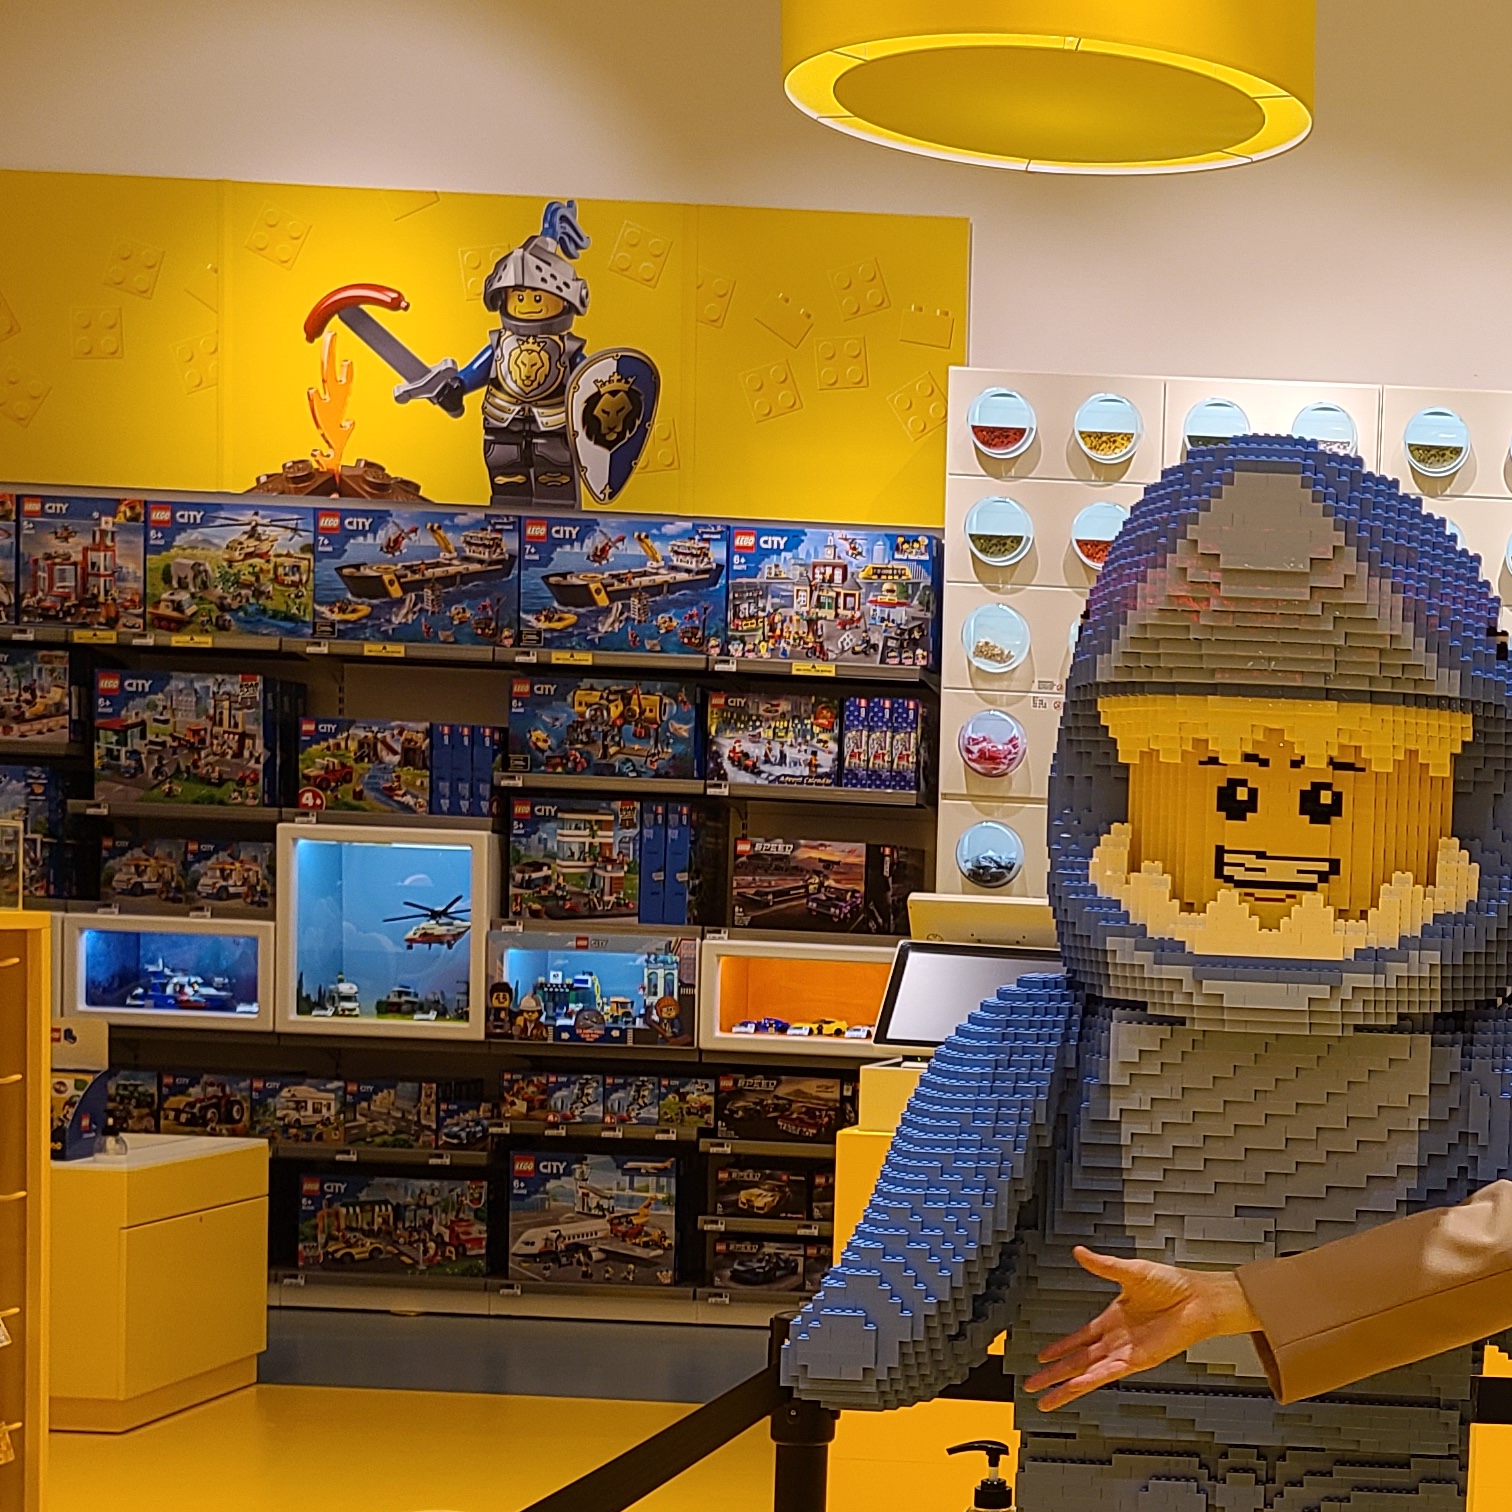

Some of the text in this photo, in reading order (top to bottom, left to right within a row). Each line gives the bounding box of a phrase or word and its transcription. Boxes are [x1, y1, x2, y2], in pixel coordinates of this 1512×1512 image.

[44, 502, 69, 514] CITY
[175, 510, 205, 524] CITY
[344, 516, 374, 531] CITY
[551, 524, 581, 540] CITY
[759, 535, 789, 551] CITY
[124, 679, 153, 693] CITY
[533, 684, 557, 696] CITY
[727, 697, 747, 708] CITY
[318, 723, 338, 733] CITY
[534, 804, 558, 817] CITY
[539, 1160, 568, 1175] CITY
[323, 1182, 347, 1194] CITY
